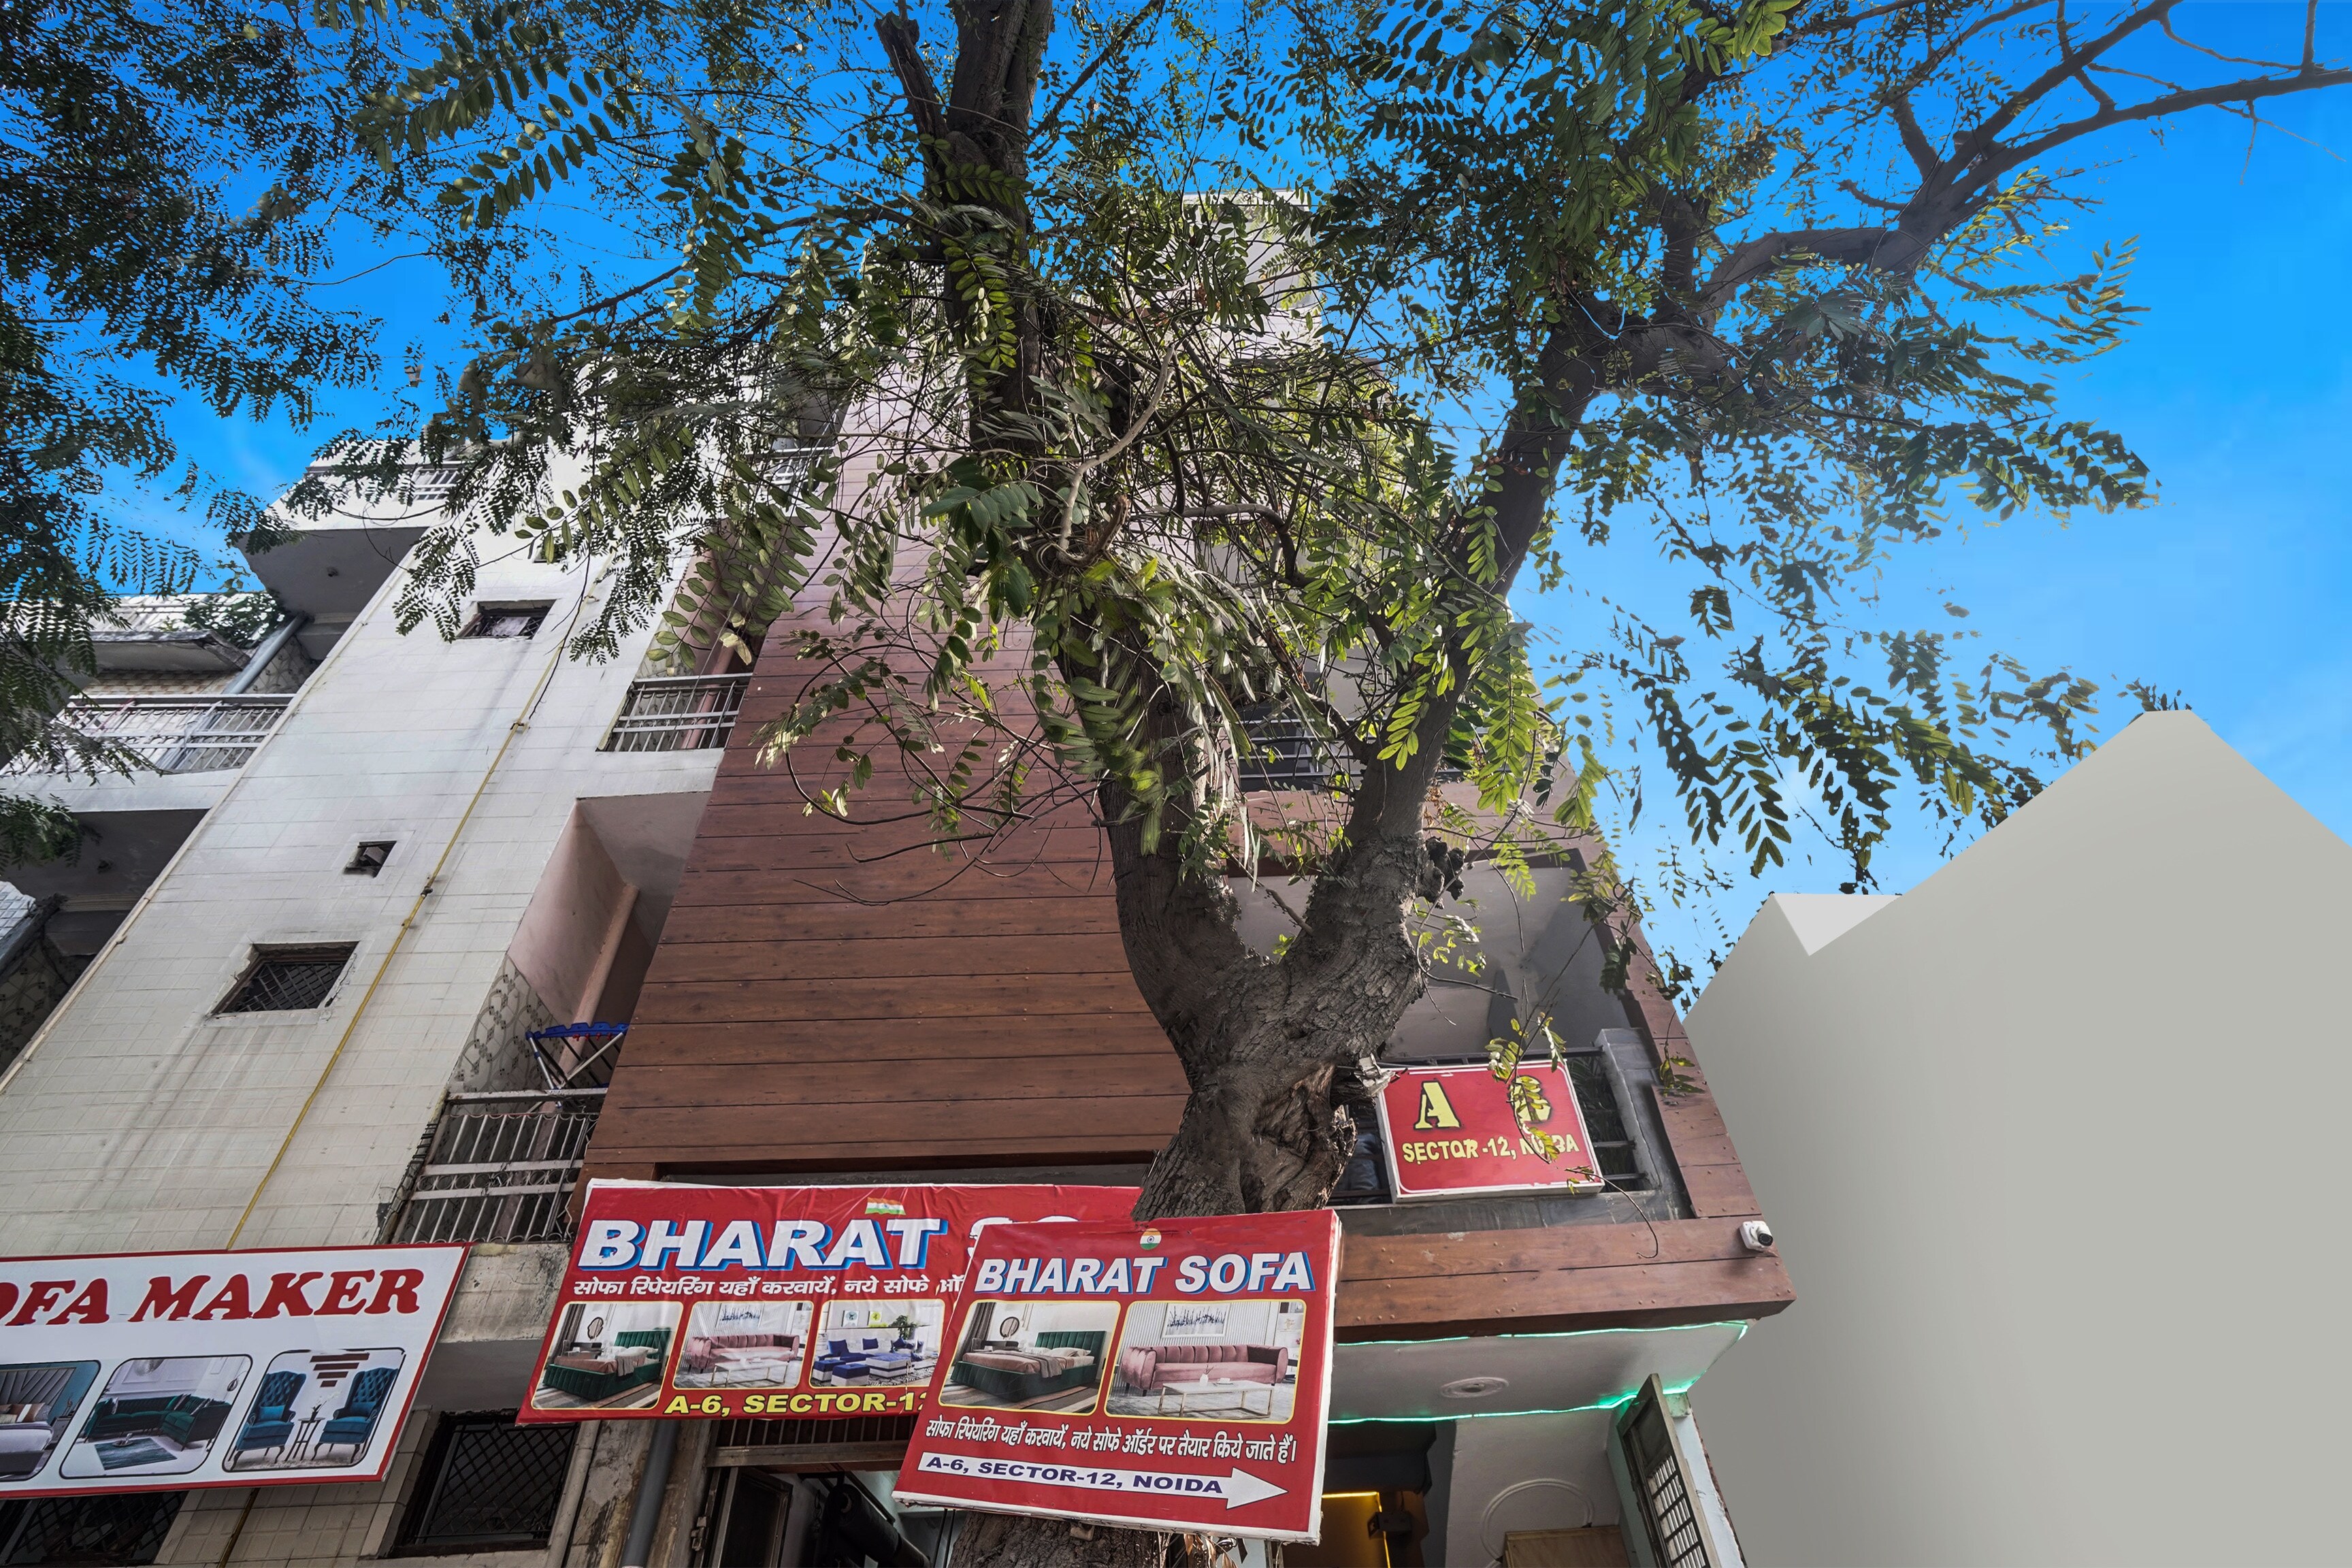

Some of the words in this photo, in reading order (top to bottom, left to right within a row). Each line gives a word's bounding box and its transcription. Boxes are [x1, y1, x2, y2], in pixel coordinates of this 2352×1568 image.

[1414, 1081, 1460, 1130] A
[578, 1219, 948, 1271] BHARAT
[574, 1276, 627, 1295] सोफा
[630, 1276, 715, 1296] रिपेयरिंग
[719, 1275, 761, 1296] यहाँ
[762, 1275, 836, 1296] करवायें,
[845, 1275, 879, 1294] नये
[883, 1274, 930, 1294] सोफे
[974, 1256, 1168, 1294] BHARAT
[1175, 1251, 1316, 1294] SOFA
[128, 1269, 425, 1322] MAKER
[664, 1394, 731, 1418] A-6,
[926, 1414, 956, 1439] सोफा
[954, 1415, 1001, 1442] रिपेयरिंग
[1000, 1420, 1028, 1447] यहाँ
[1024, 1423, 1069, 1450] करवायें,
[1071, 1424, 1092, 1451] नये
[1092, 1426, 1122, 1452] सोफे
[1122, 1427, 1158, 1455] ऑर्डर
[1158, 1433, 1177, 1455] पर
[1177, 1428, 1212, 1458] तैयार
[1211, 1430, 1243, 1459] किये
[1245, 1433, 1276, 1462] जाते
[926, 1456, 969, 1474] A-6,
[978, 1462, 1123, 1490] SECTOR-12,
[1132, 1474, 1223, 1494] NOIDA
